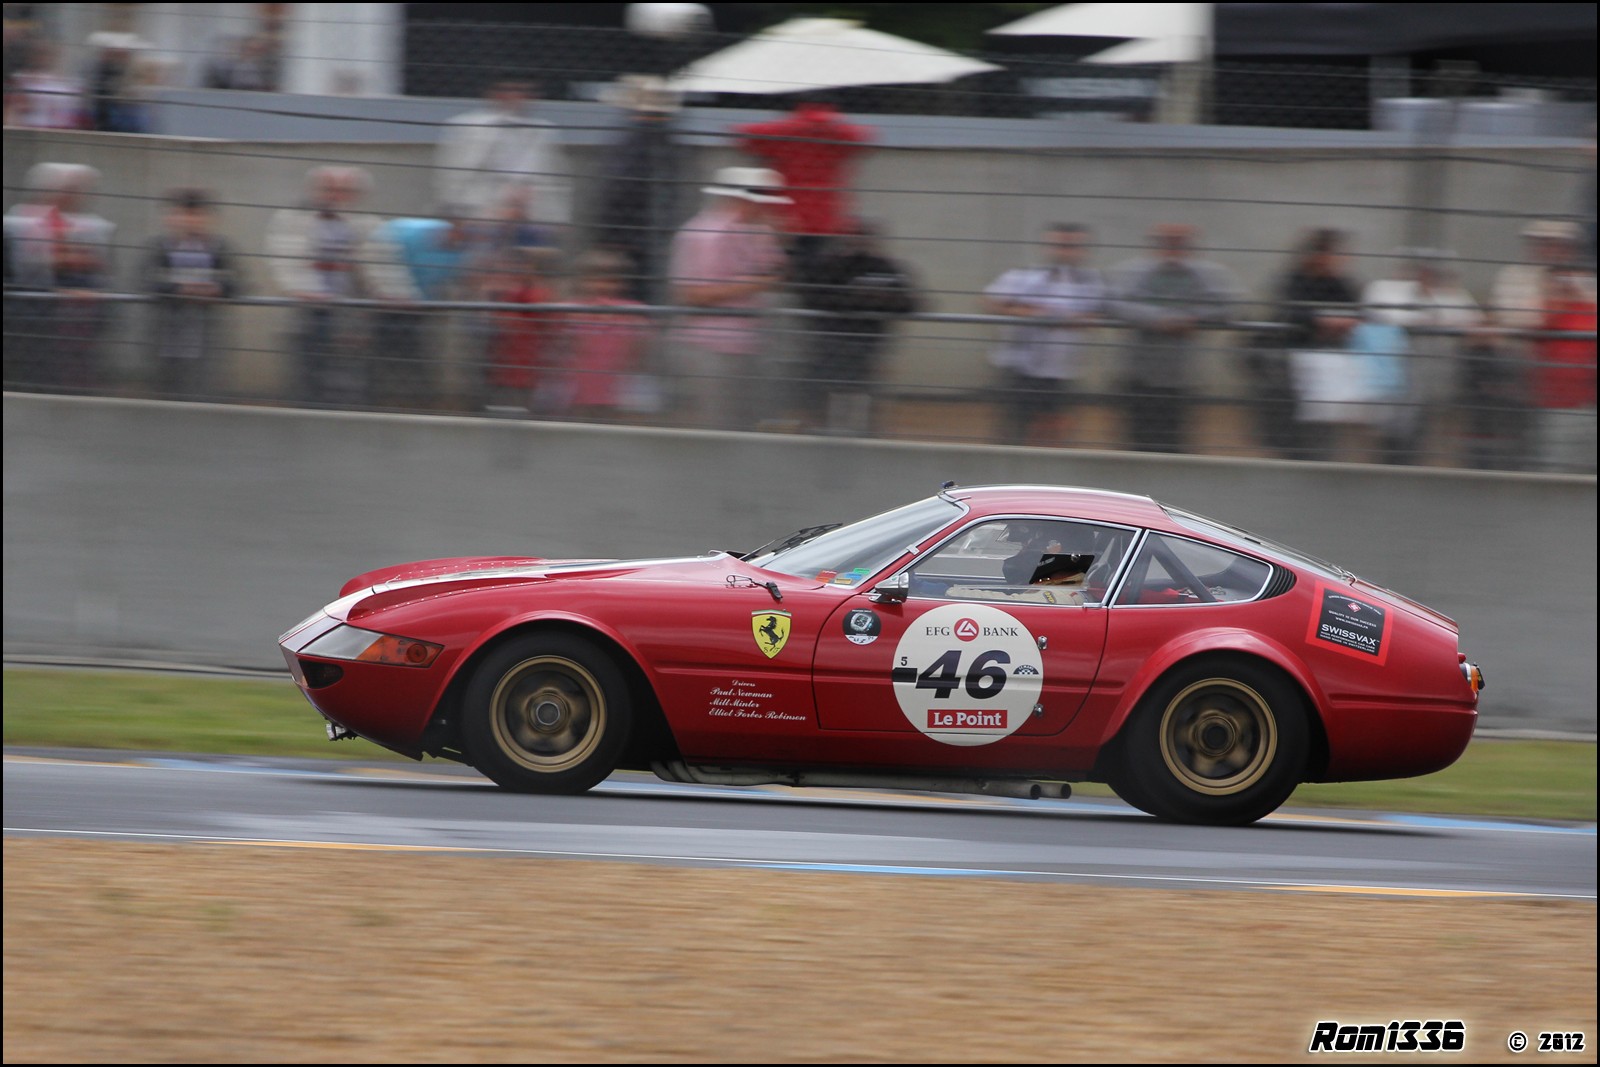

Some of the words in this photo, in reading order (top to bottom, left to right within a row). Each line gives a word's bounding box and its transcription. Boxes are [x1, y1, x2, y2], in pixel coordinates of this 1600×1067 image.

[925, 626, 950, 637] EFG
[983, 627, 1018, 637] BANK
[1321, 623, 1376, 646] SWISSVAX
[900, 656, 908, 666] 5
[915, 650, 1011, 700] 46
[732, 679, 756, 687] Drivers
[710, 687, 734, 696] Paul
[732, 688, 773, 698] Newman
[708, 707, 734, 717] Elliot
[734, 708, 763, 719] Forbes
[764, 710, 807, 721] Robinson
[933, 712, 953, 726] Le
[956, 711, 1002, 726] Point
